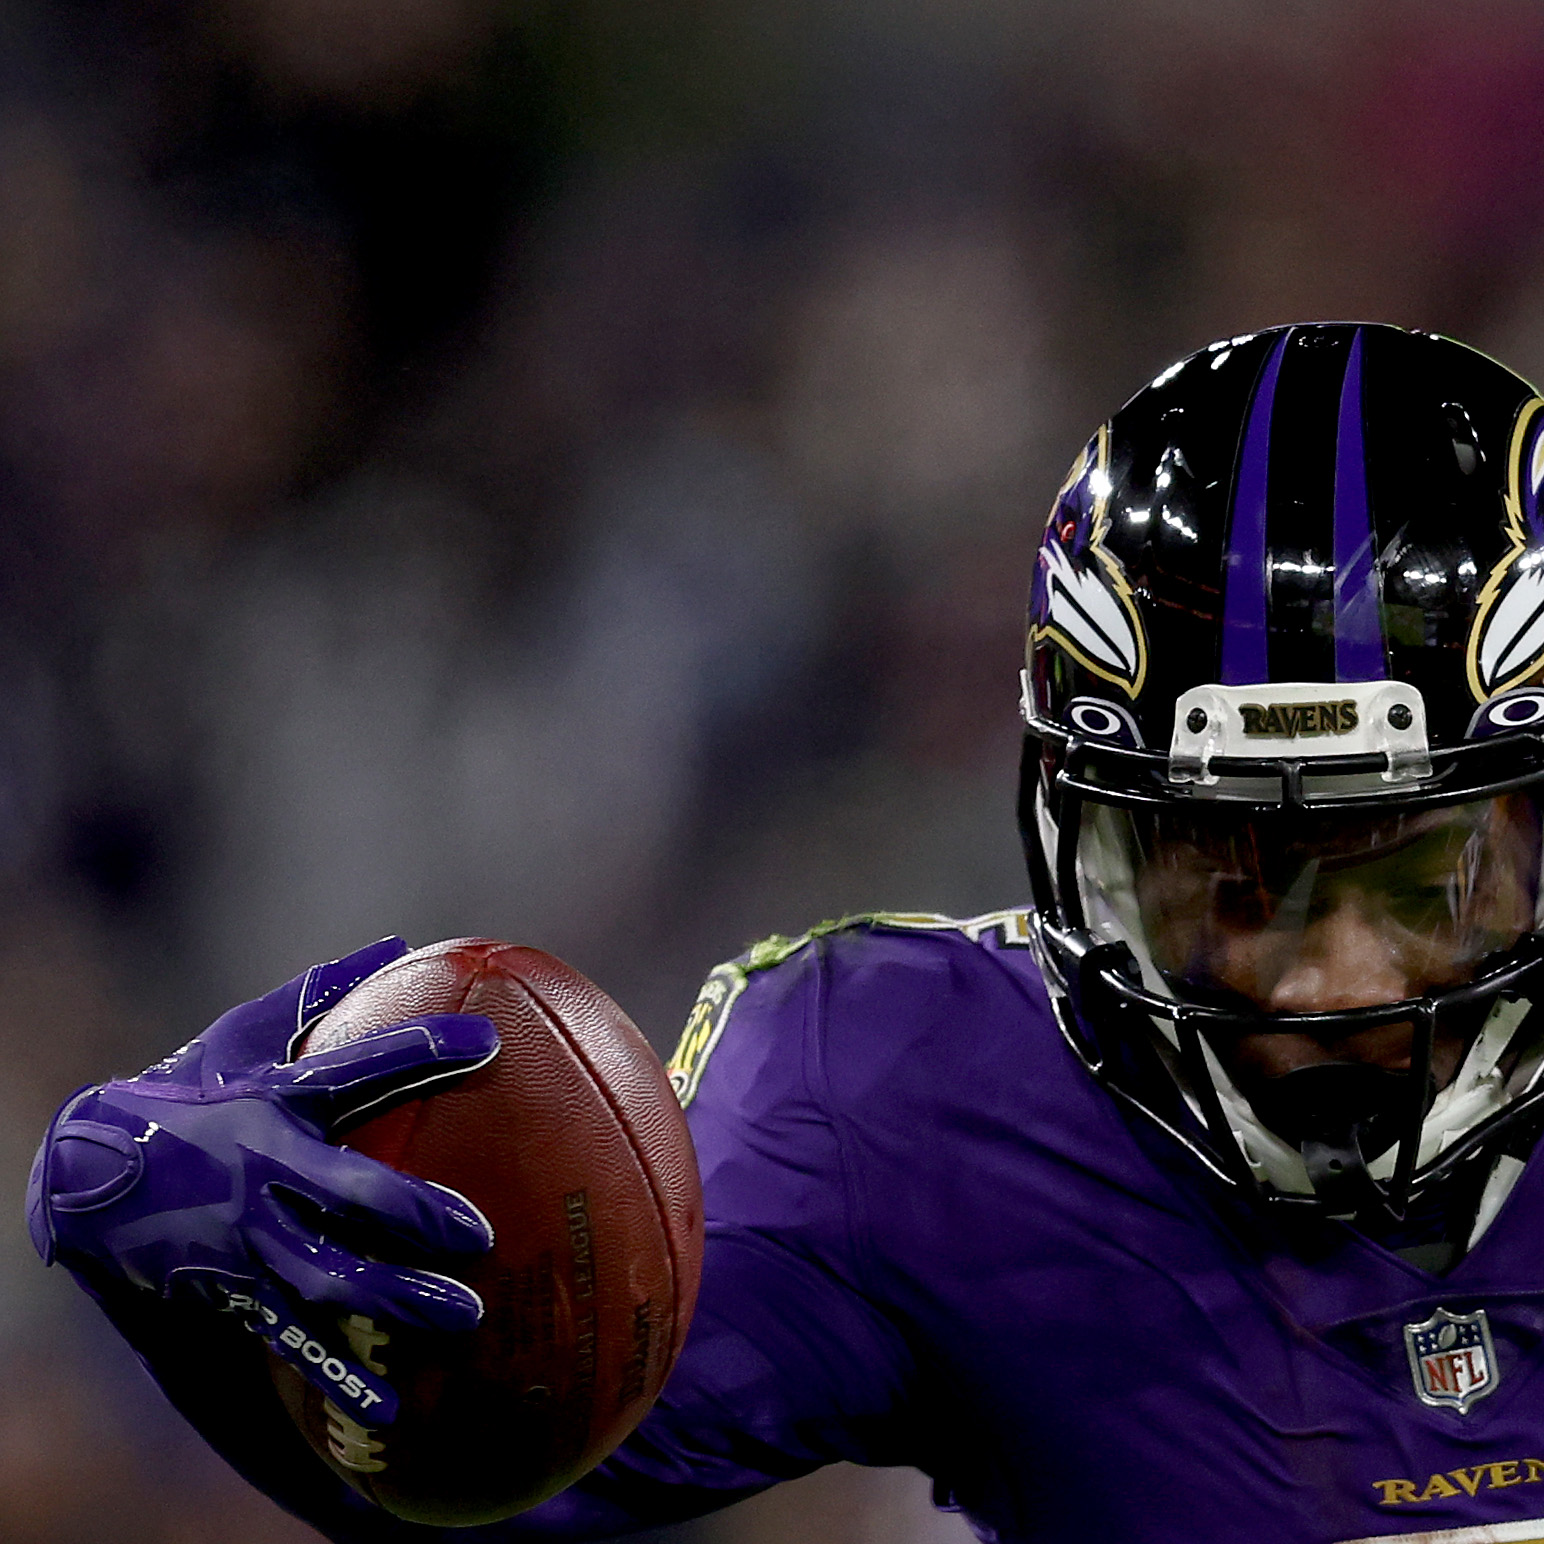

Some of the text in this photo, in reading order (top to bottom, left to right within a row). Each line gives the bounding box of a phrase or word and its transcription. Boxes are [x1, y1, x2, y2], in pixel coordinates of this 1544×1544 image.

[1238, 699, 1359, 740] RAVENS
[565, 1189, 597, 1301] LEAGUE
[279, 1325, 383, 1409] BOOST
[1424, 1351, 1485, 1393] NFL
